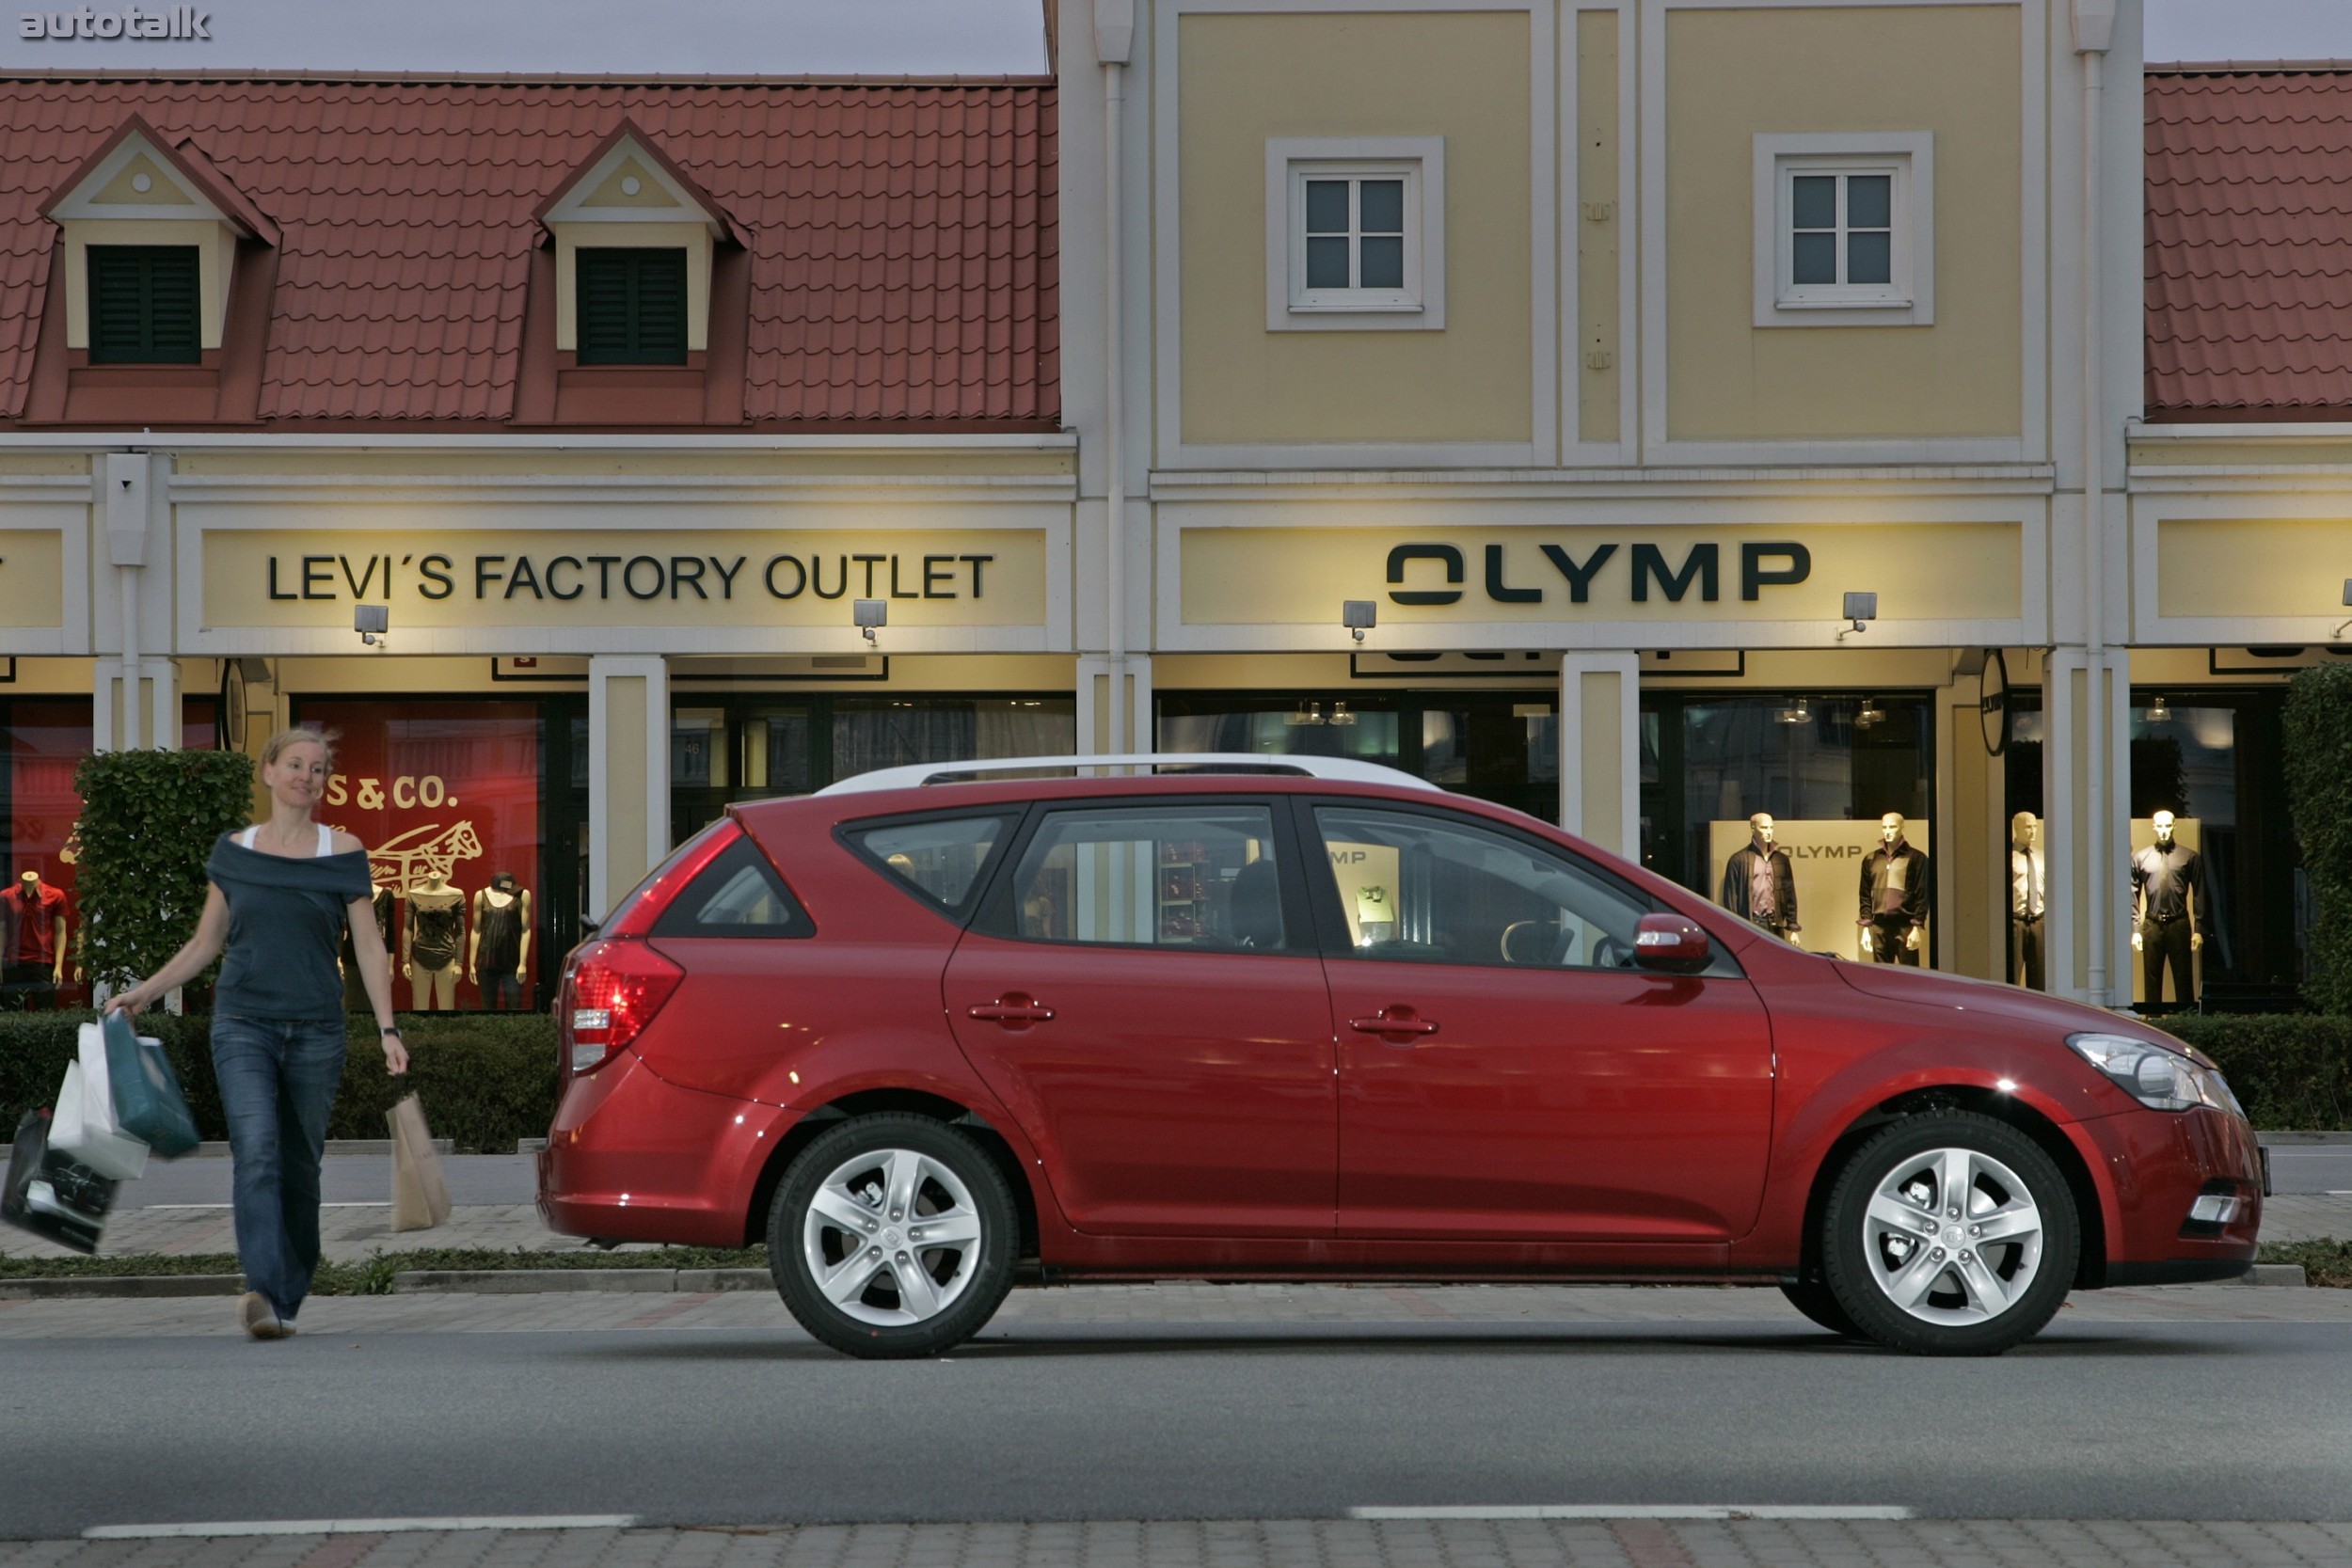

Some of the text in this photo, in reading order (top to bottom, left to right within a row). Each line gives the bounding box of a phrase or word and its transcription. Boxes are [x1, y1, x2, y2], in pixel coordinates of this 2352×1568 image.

[474, 555, 746, 600] FACTORY
[764, 555, 993, 600] OUTLET
[1386, 542, 1812, 606] OLYMP
[685, 743, 700, 754] 46
[357, 778, 386, 811] &
[393, 775, 458, 810] CO.
